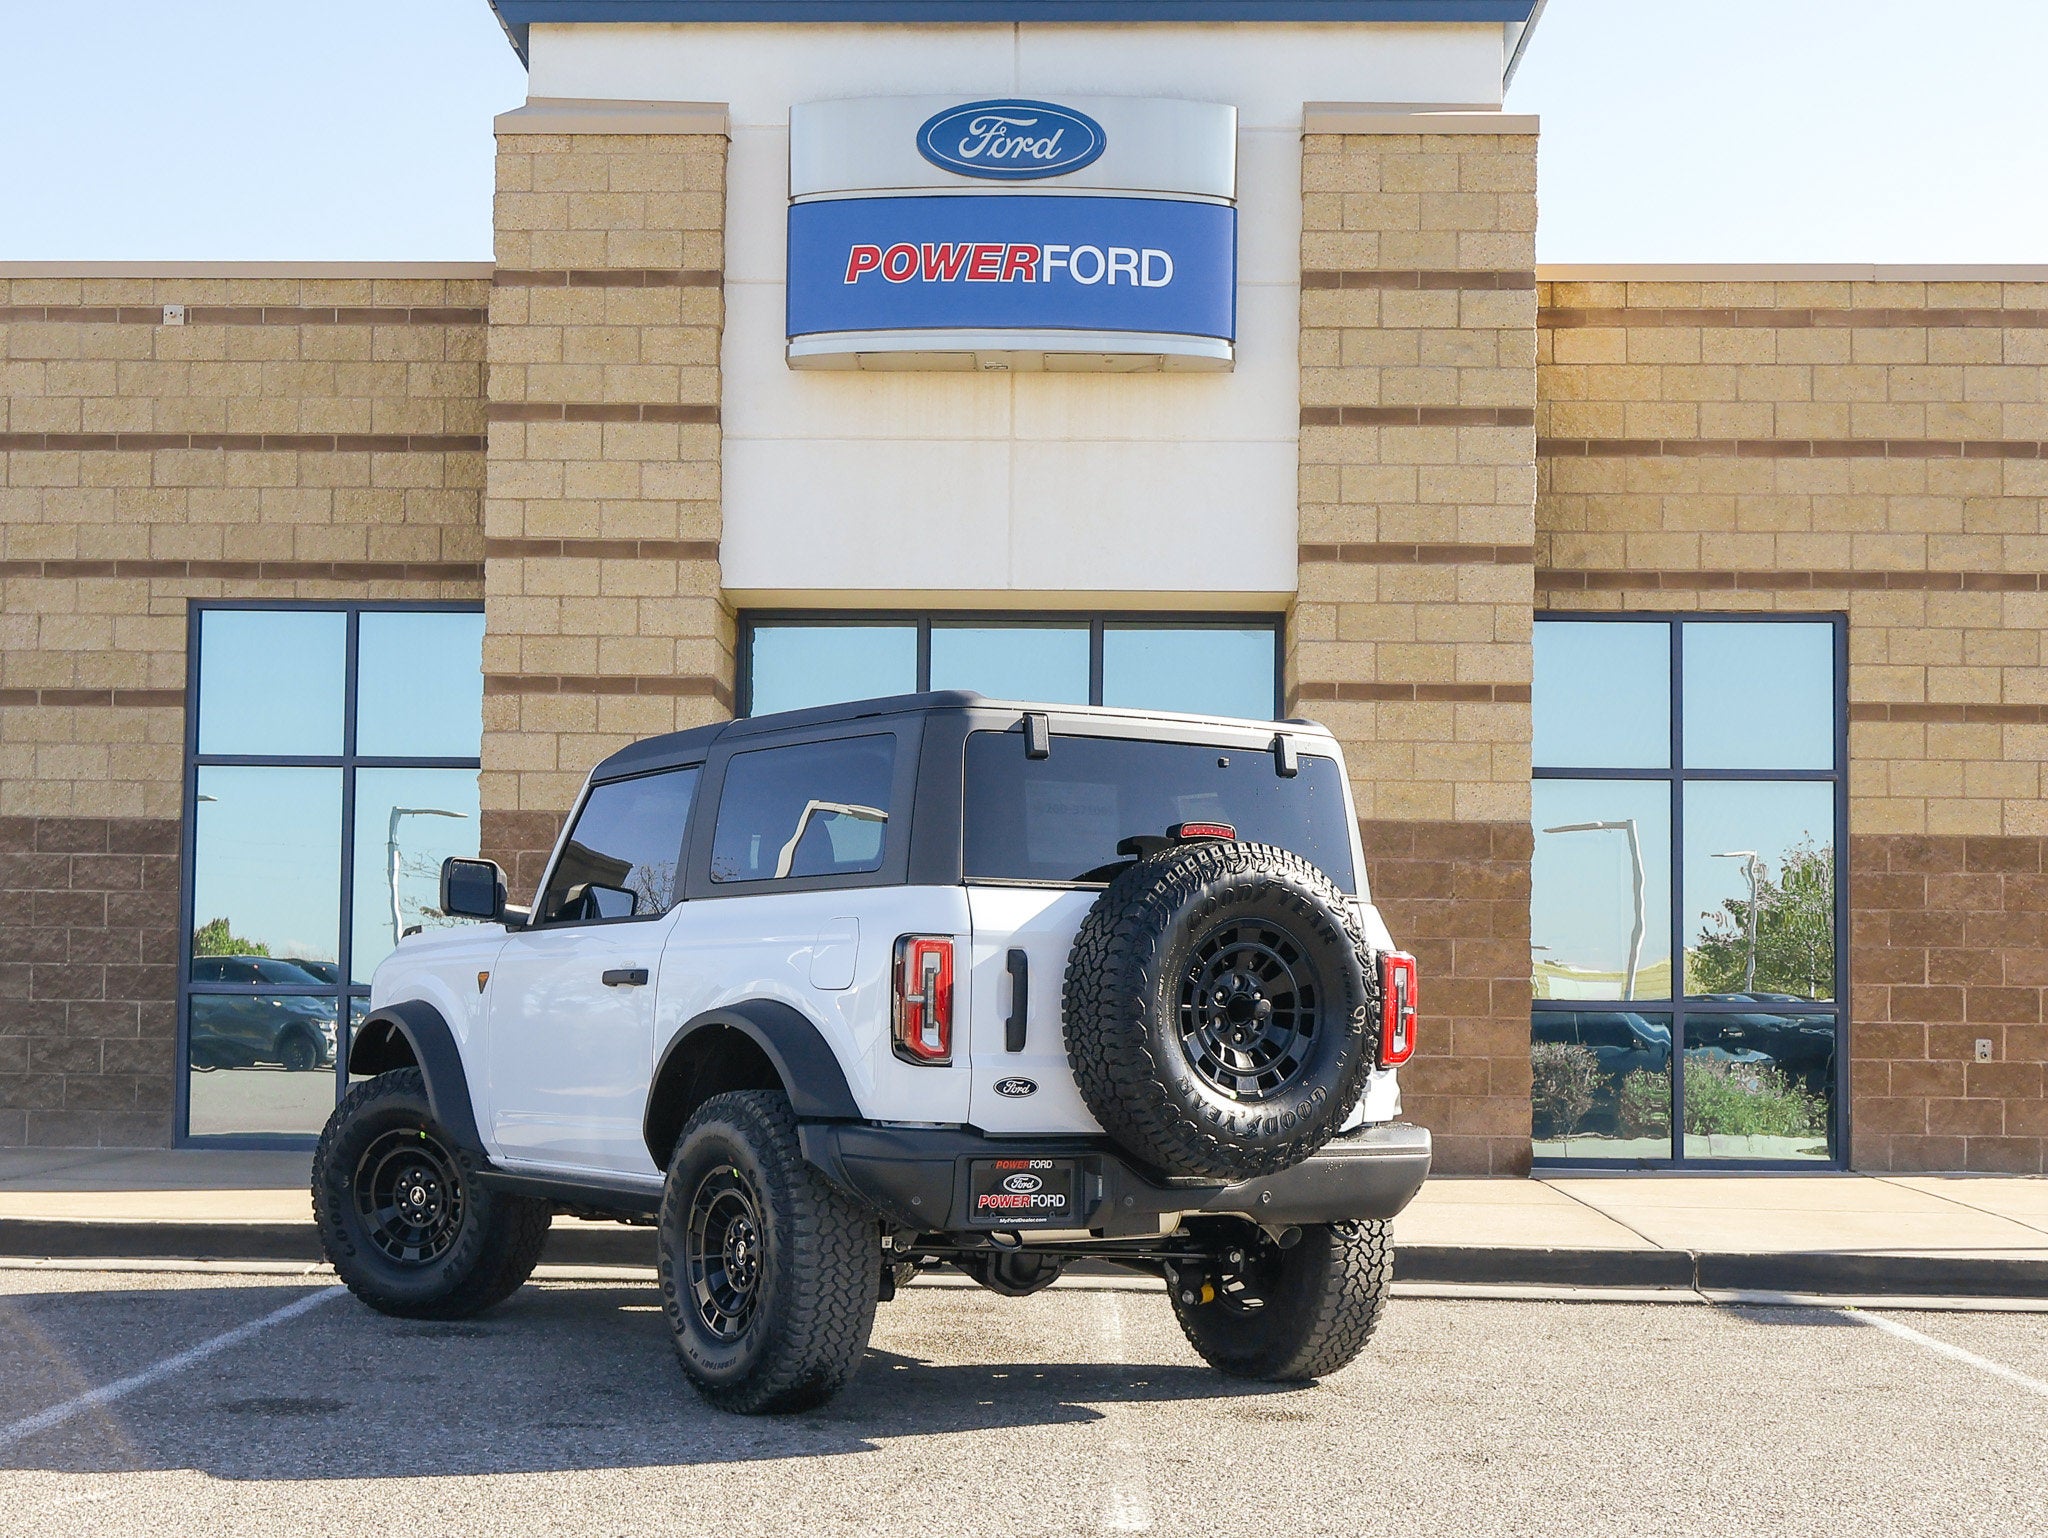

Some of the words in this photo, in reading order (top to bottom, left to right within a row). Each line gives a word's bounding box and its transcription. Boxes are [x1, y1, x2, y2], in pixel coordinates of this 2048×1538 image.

[959, 116, 1062, 160] Ford
[843, 242, 1174, 288] POWERFORD
[1003, 1079, 1031, 1095] Ford
[1010, 1177, 1035, 1189] Ford
[978, 1194, 1065, 1208] POWERFORD
